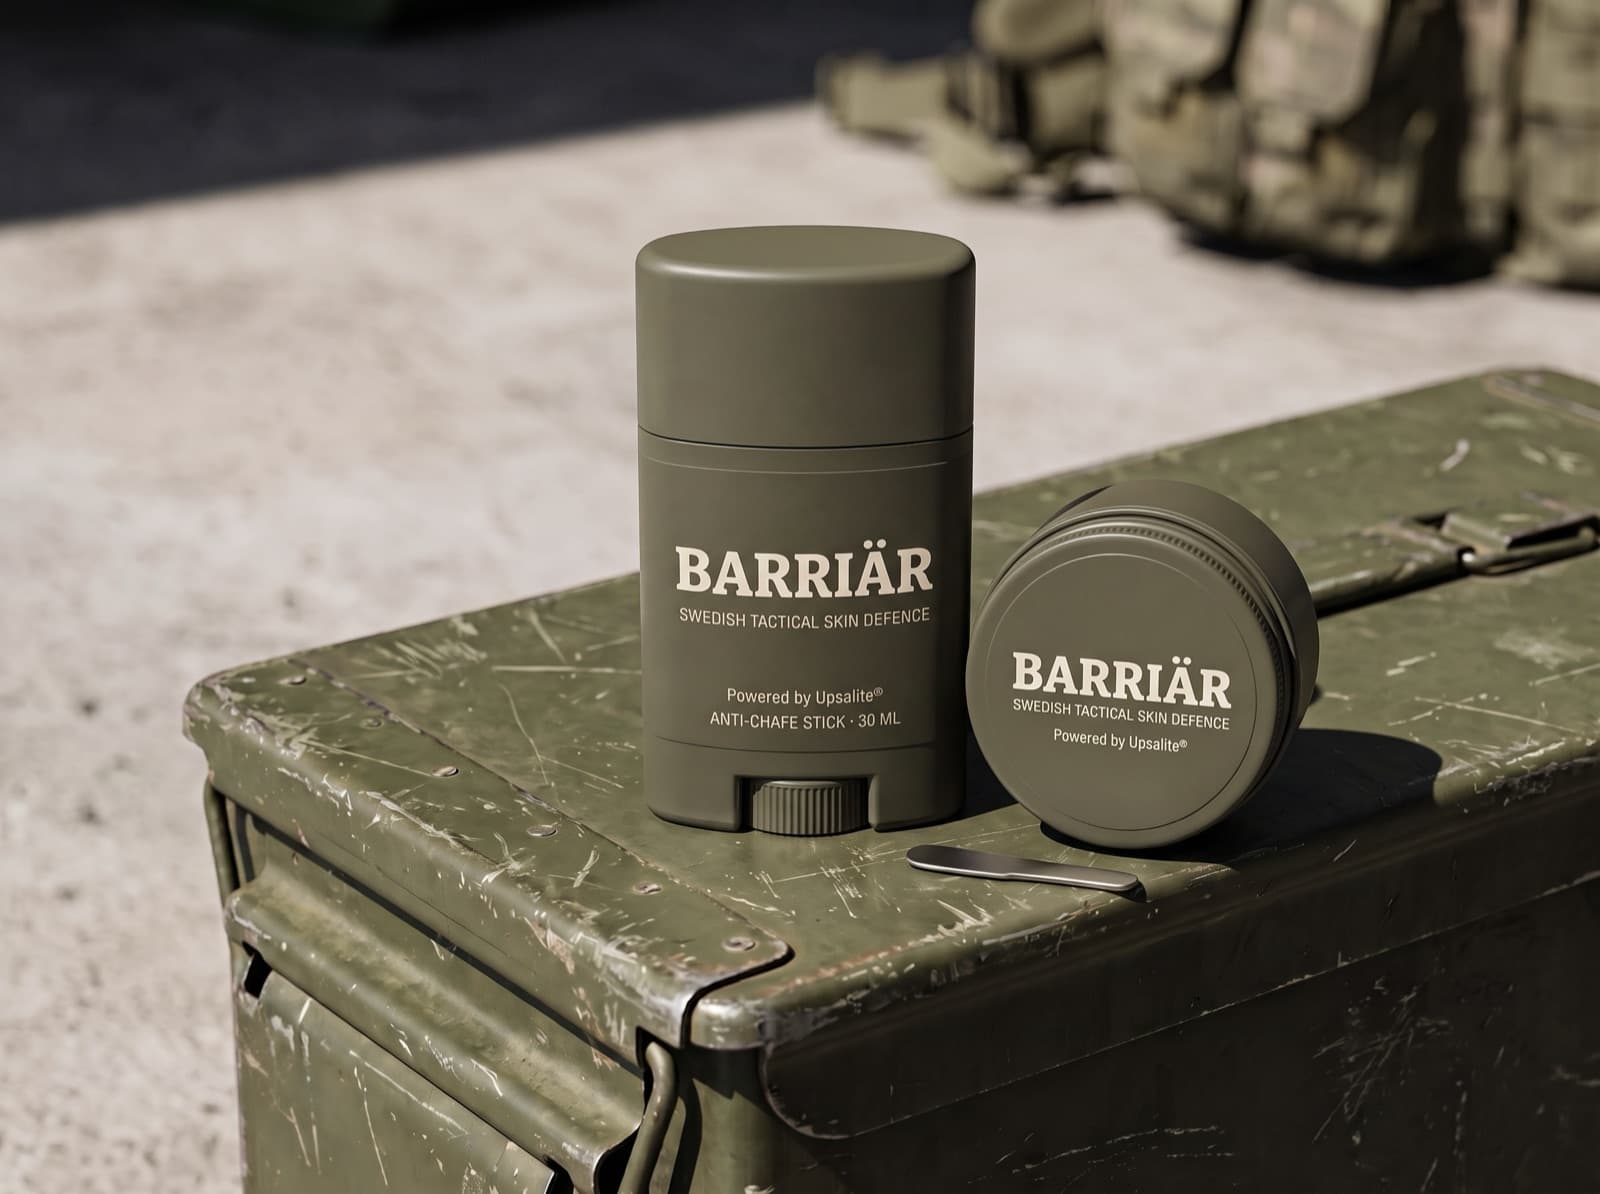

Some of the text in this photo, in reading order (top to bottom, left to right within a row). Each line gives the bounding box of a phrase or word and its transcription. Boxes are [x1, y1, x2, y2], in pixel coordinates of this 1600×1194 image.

[676, 539, 933, 598] BARRIÄR
[680, 607, 930, 629] SWEDISH TACTICAL SKIN DEFENCE
[1013, 652, 1231, 710] BARRIÄR
[728, 687, 883, 708] Powered by Upsalite®
[710, 712, 798, 729] ANTI-CHAFE
[803, 715, 845, 729] STICK
[858, 713, 875, 728] 30
[880, 712, 901, 726] ML
[1013, 698, 1230, 730] SWEDISH TACTICAL SKIN DEFENCE
[1054, 728, 1187, 752] Powered by Upsalite®
